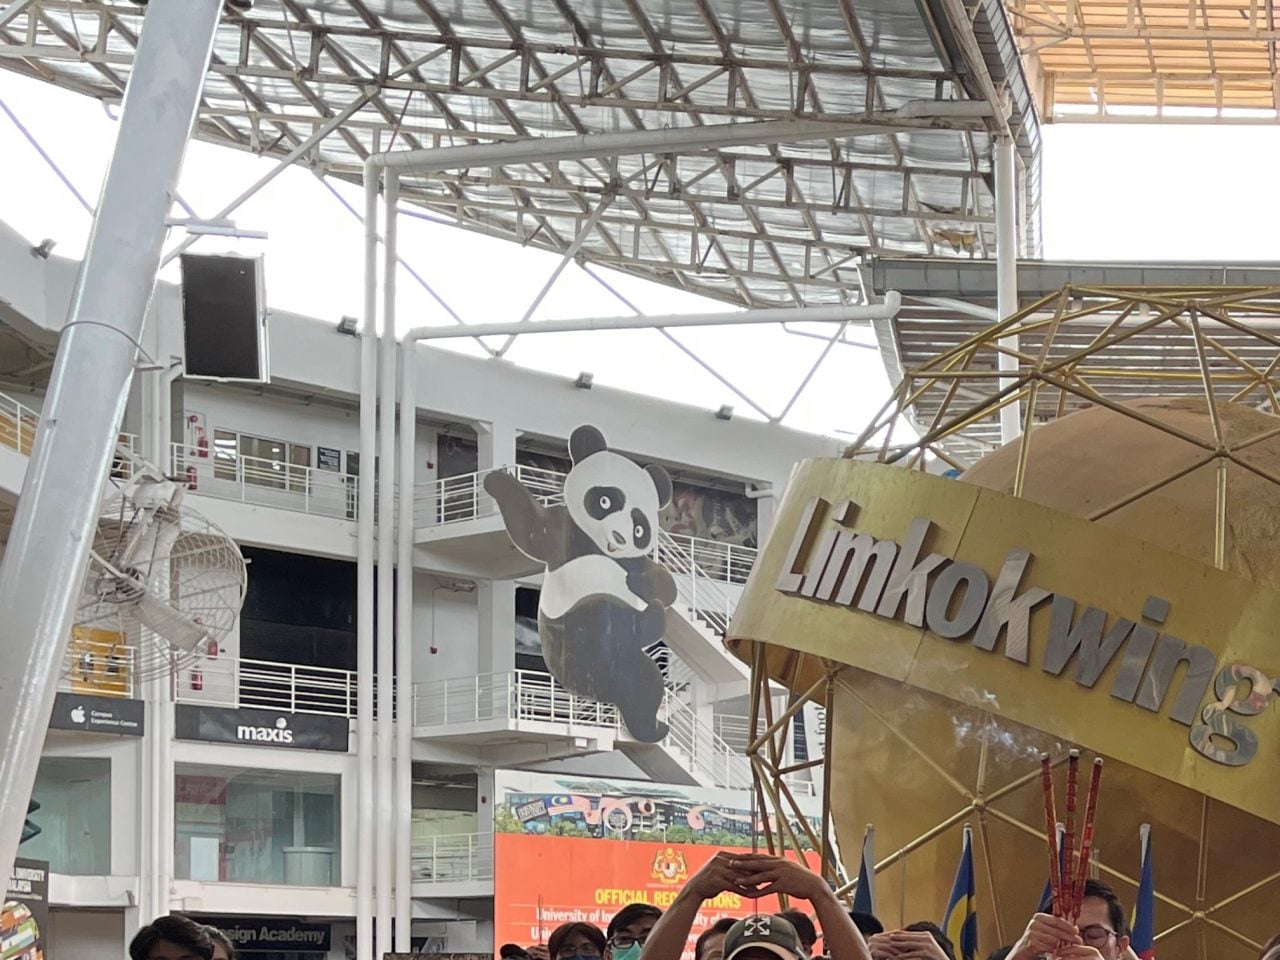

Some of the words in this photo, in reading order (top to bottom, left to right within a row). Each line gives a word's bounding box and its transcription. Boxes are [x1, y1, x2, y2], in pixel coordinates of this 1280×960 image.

[237, 717, 294, 744] maxis
[595, 889, 648, 905] OFFICIAL
[536, 907, 586, 922] University
[589, 910, 600, 922] of
[259, 926, 325, 945] Academy
